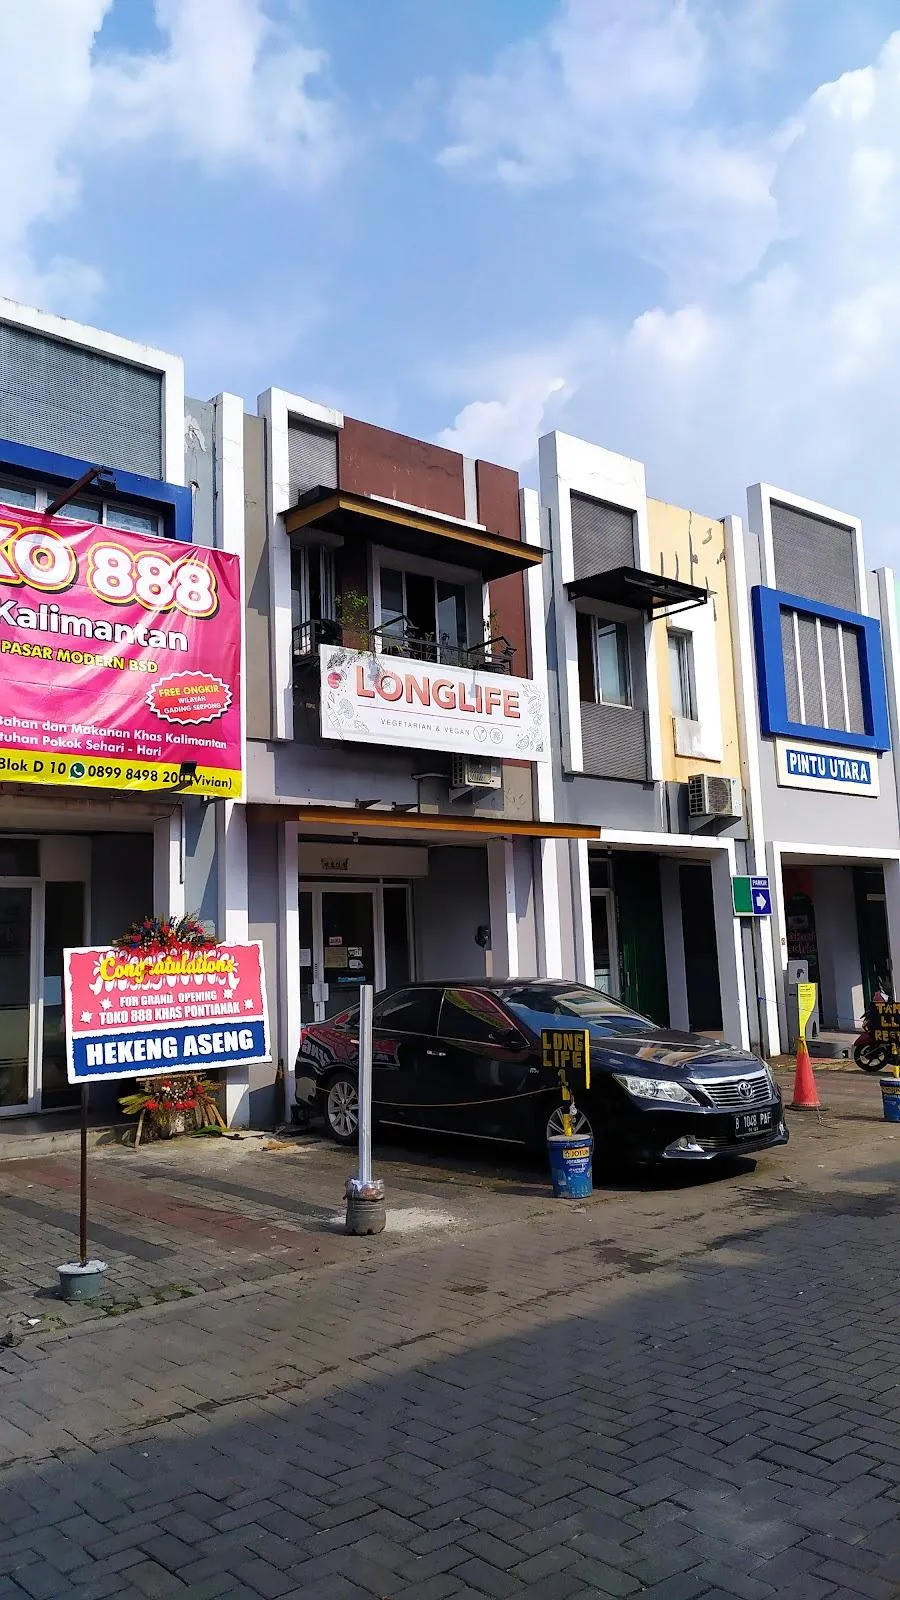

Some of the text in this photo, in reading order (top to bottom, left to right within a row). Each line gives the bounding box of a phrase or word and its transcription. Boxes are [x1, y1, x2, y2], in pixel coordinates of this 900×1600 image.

[86, 541, 219, 619] 888
[0, 600, 189, 652] Kalimantan
[1, 640, 158, 673] PASAR MODERN BSD
[159, 684, 219, 697] FREE ONGKIR
[355, 665, 521, 719] LONGLIFE
[164, 703, 221, 714] GADING SERPONG
[42, 720, 67, 733] dan
[71, 723, 130, 739] Makanan
[133, 729, 162, 743] Khas
[165, 733, 227, 749] Kalimantan
[381, 717, 432, 732] VEGETARIAN
[445, 726, 470, 736] VEGAN
[42, 735, 82, 749] Pokok
[86, 739, 124, 753] Sehari
[137, 744, 162, 757] Hari
[33, 760, 44, 773] D
[50, 761, 67, 775] 10
[88, 765, 122, 779] 0899
[126, 768, 158, 782] 8498
[790, 752, 869, 782] PINTU UTARA
[752, 879, 768, 887] PARKIR
[100, 953, 234, 984] Congatulations
[119, 990, 217, 1008] FOR GRAND OPENING
[99, 1001, 240, 1025] TOKO 888 KHAS PONTIANAK
[86, 1029, 254, 1067] HEKENG ASENG
[542, 1032, 583, 1051] LONG
[542, 1050, 582, 1069] LIFE
[735, 1117, 740, 1130] B
